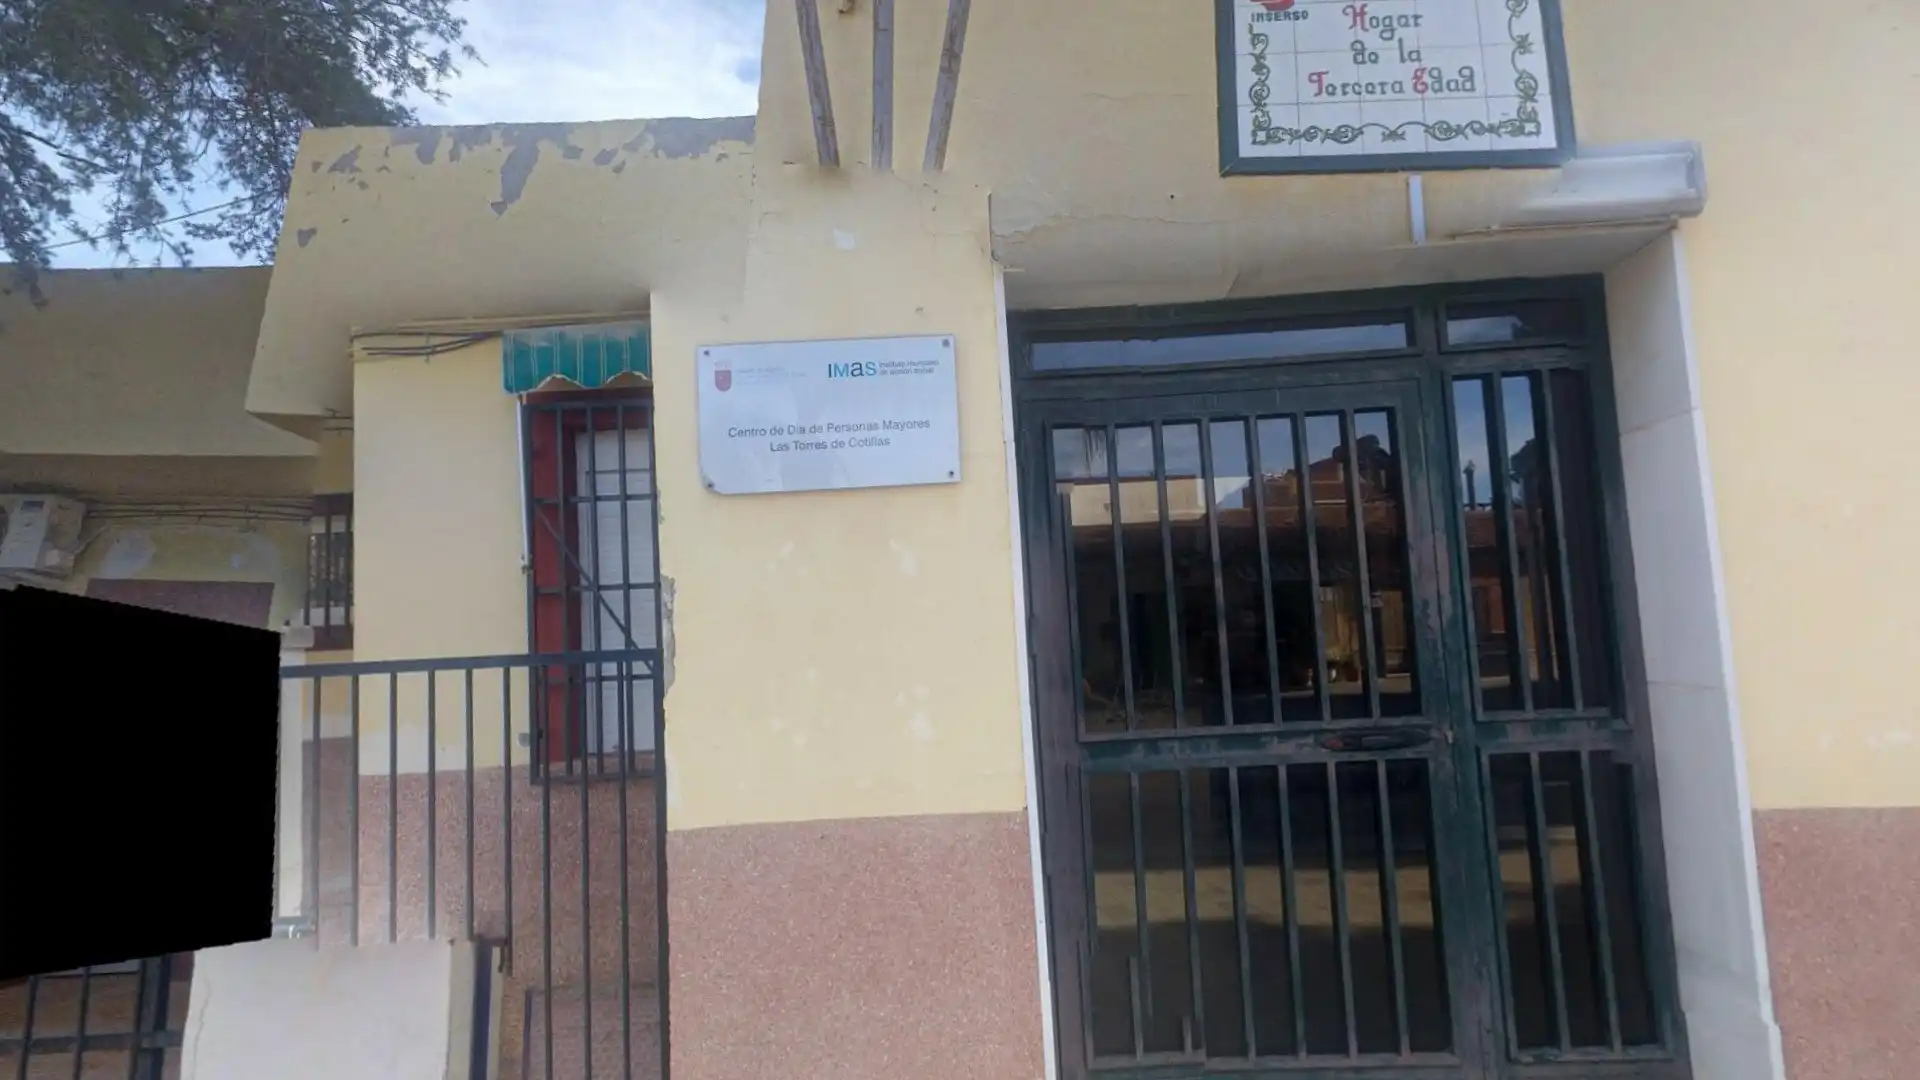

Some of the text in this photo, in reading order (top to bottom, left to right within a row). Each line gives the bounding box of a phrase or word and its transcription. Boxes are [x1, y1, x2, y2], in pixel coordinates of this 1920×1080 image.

[1250, 10, 1309, 22] INSERSO
[1342, 3, 1423, 41] Hogar
[1351, 37, 1422, 65] de la
[1308, 66, 1476, 97] Tercera Edad
[728, 426, 767, 438] Centro
[769, 425, 784, 436] de
[809, 423, 823, 434] de
[826, 421, 880, 433] Personas
[882, 419, 931, 431] Mayores
[770, 436, 891, 452] Las Torres de Cotillas
